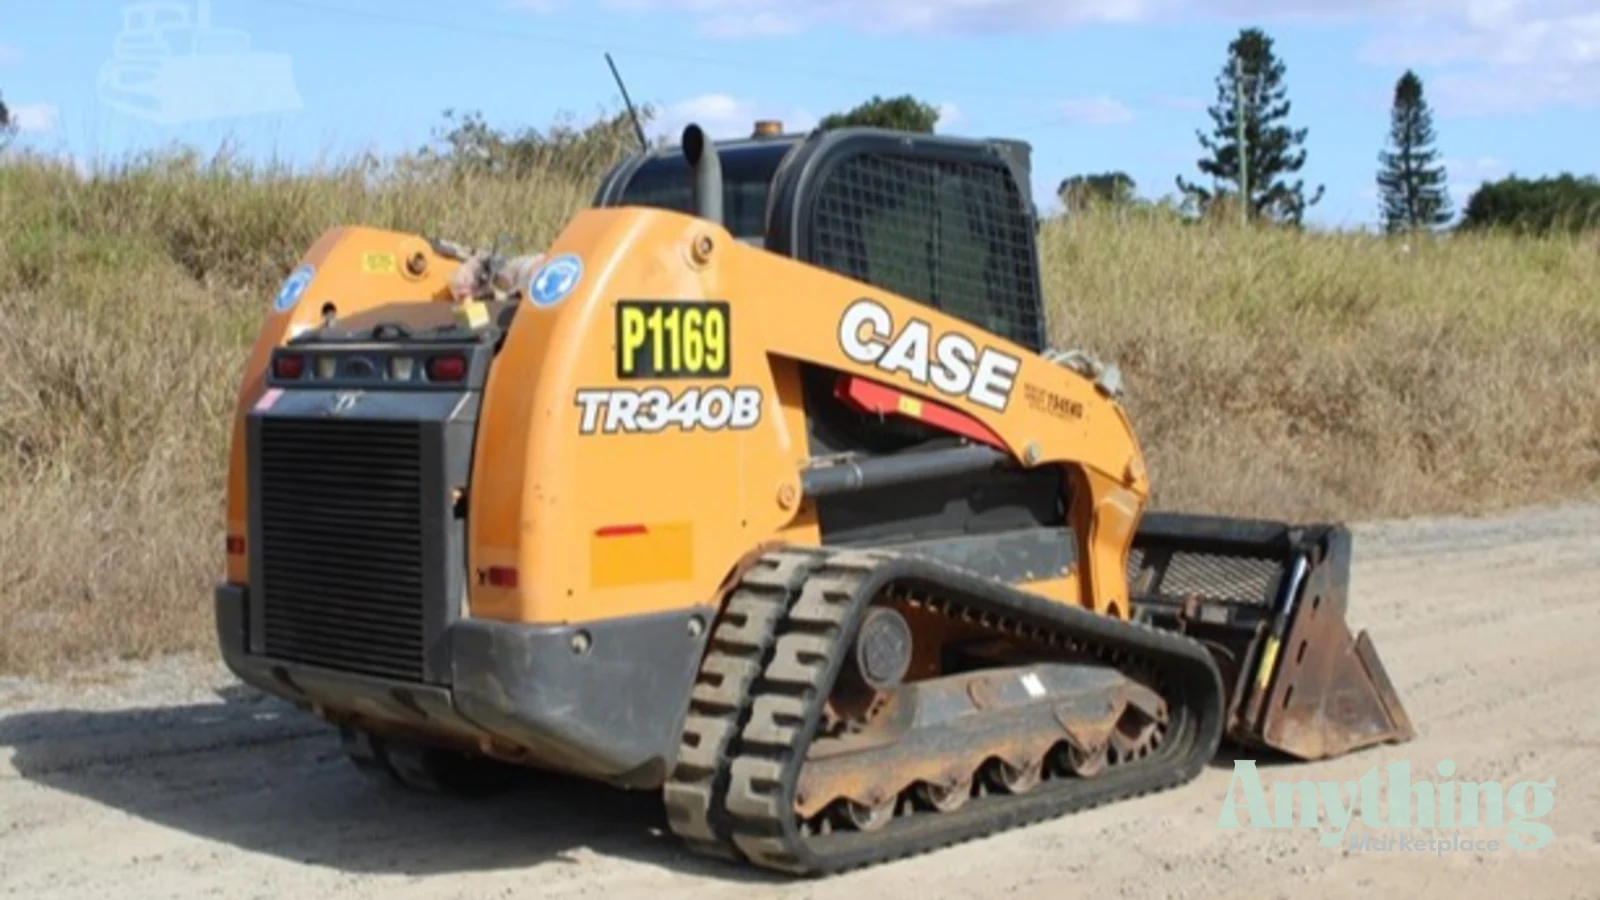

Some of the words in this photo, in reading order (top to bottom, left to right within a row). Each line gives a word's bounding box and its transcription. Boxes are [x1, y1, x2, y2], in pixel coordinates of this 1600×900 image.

[621, 307, 725, 372] P1169
[839, 298, 1020, 412] CASE
[576, 387, 762, 434] TR340B
